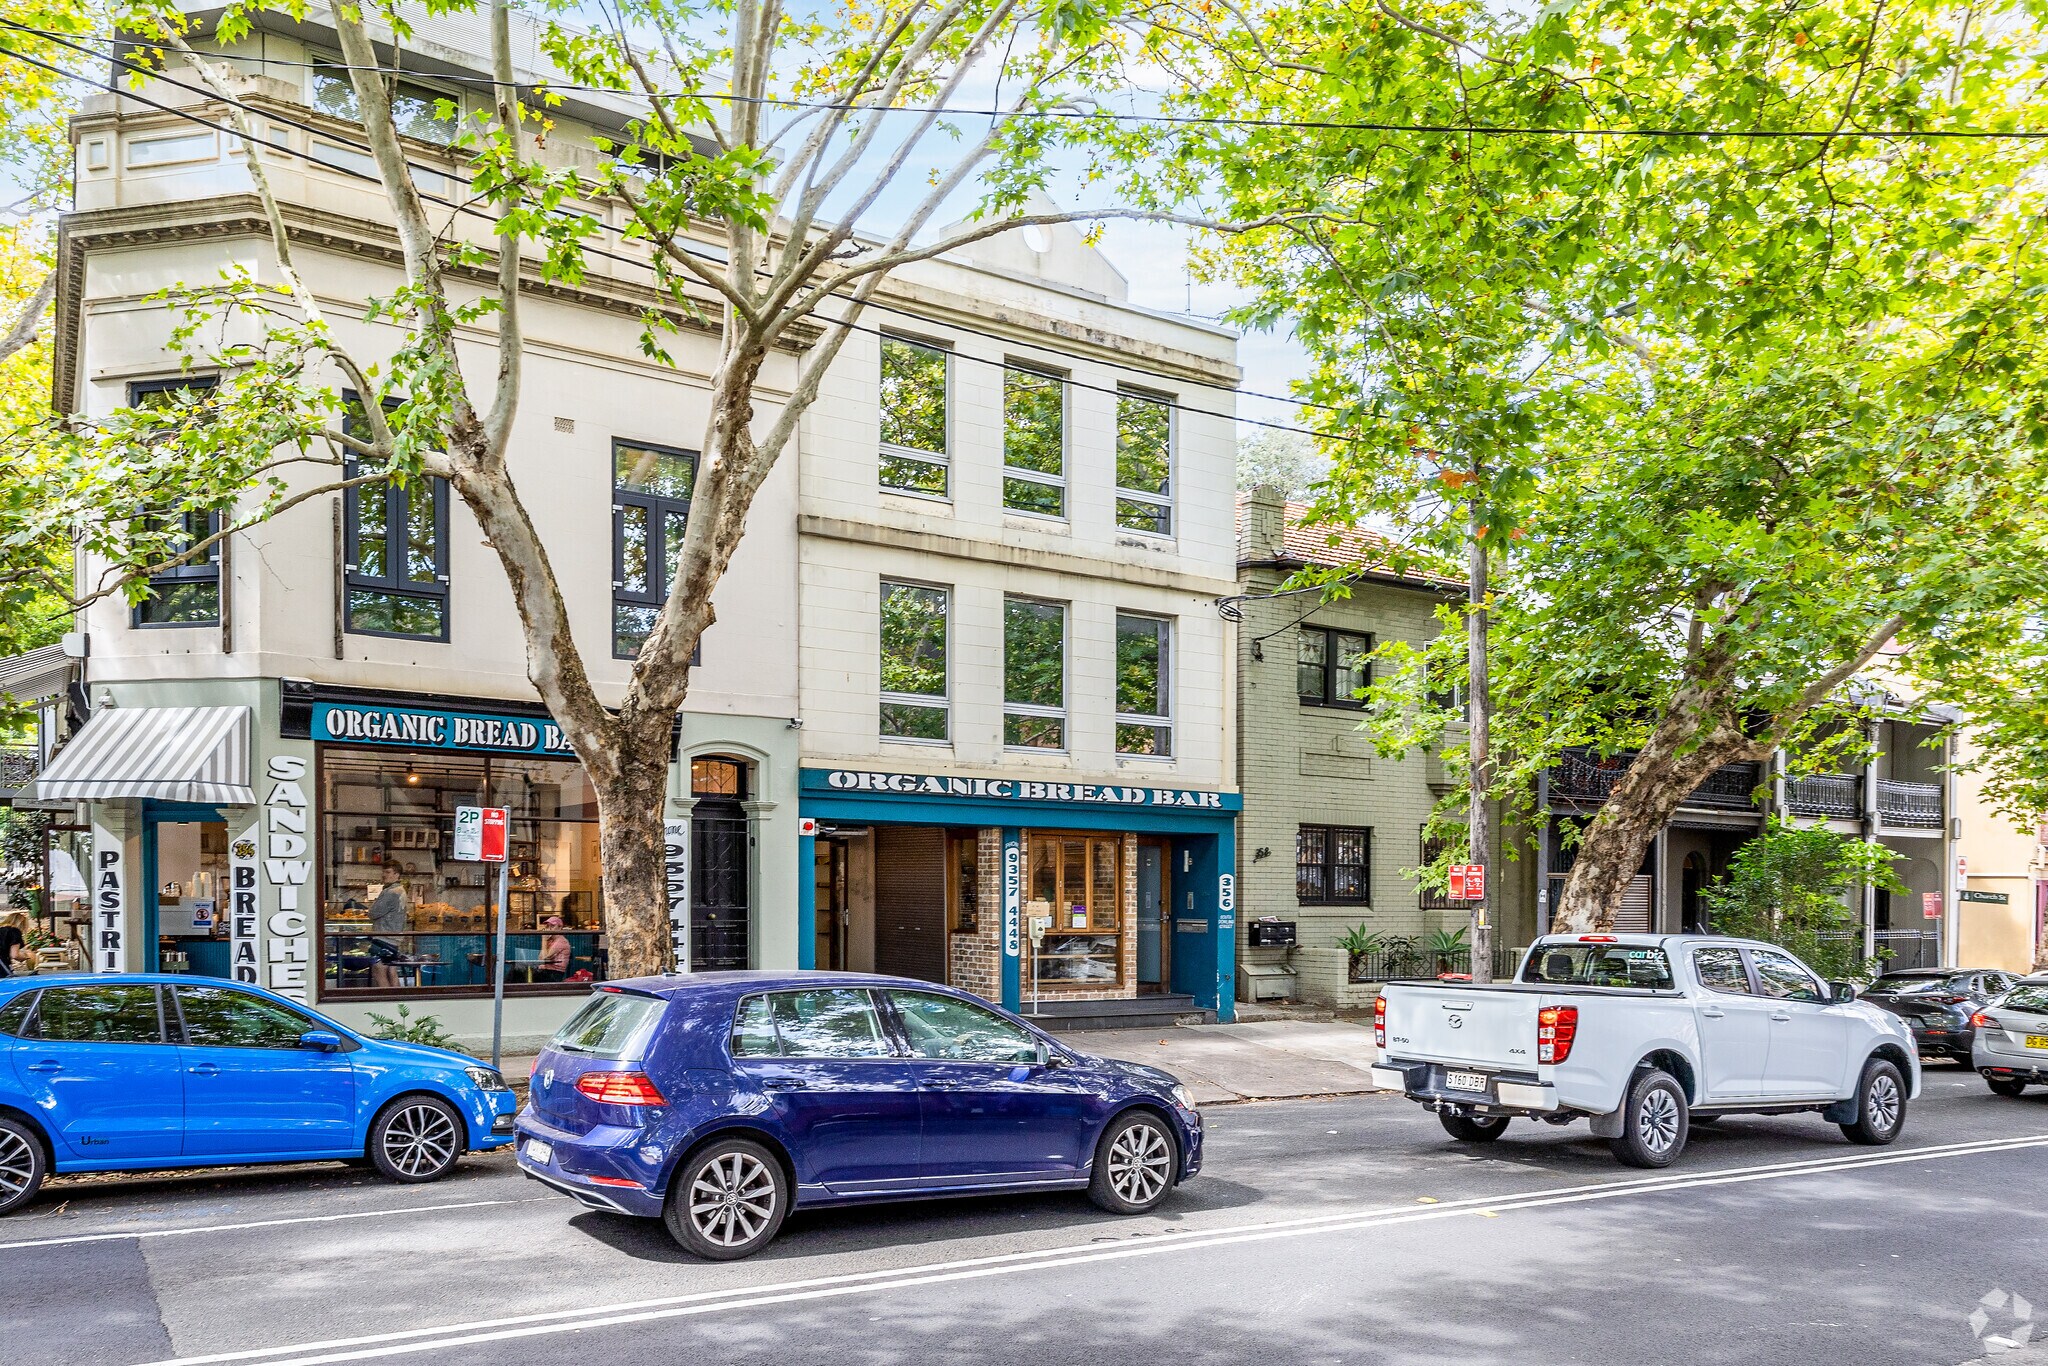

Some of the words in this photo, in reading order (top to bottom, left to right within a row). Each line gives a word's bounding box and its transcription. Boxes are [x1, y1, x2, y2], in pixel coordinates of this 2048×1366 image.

[326, 708, 446, 744] ORGANIC
[453, 717, 538, 750] BREAD
[543, 723, 576, 751] BA
[827, 770, 1013, 799] ORGANIC
[1018, 781, 1145, 805] BREAD
[1152, 789, 1222, 809] BAR
[459, 811, 479, 824] 2P
[1008, 853, 1018, 897] 9357
[1222, 877, 1231, 908] 356
[99, 850, 121, 974] PASTRI
[1974, 892, 1997, 900] Church
[233, 865, 257, 984] BREAD
[1008, 906, 1018, 950] 4448
[1629, 949, 1665, 960] carbiz
